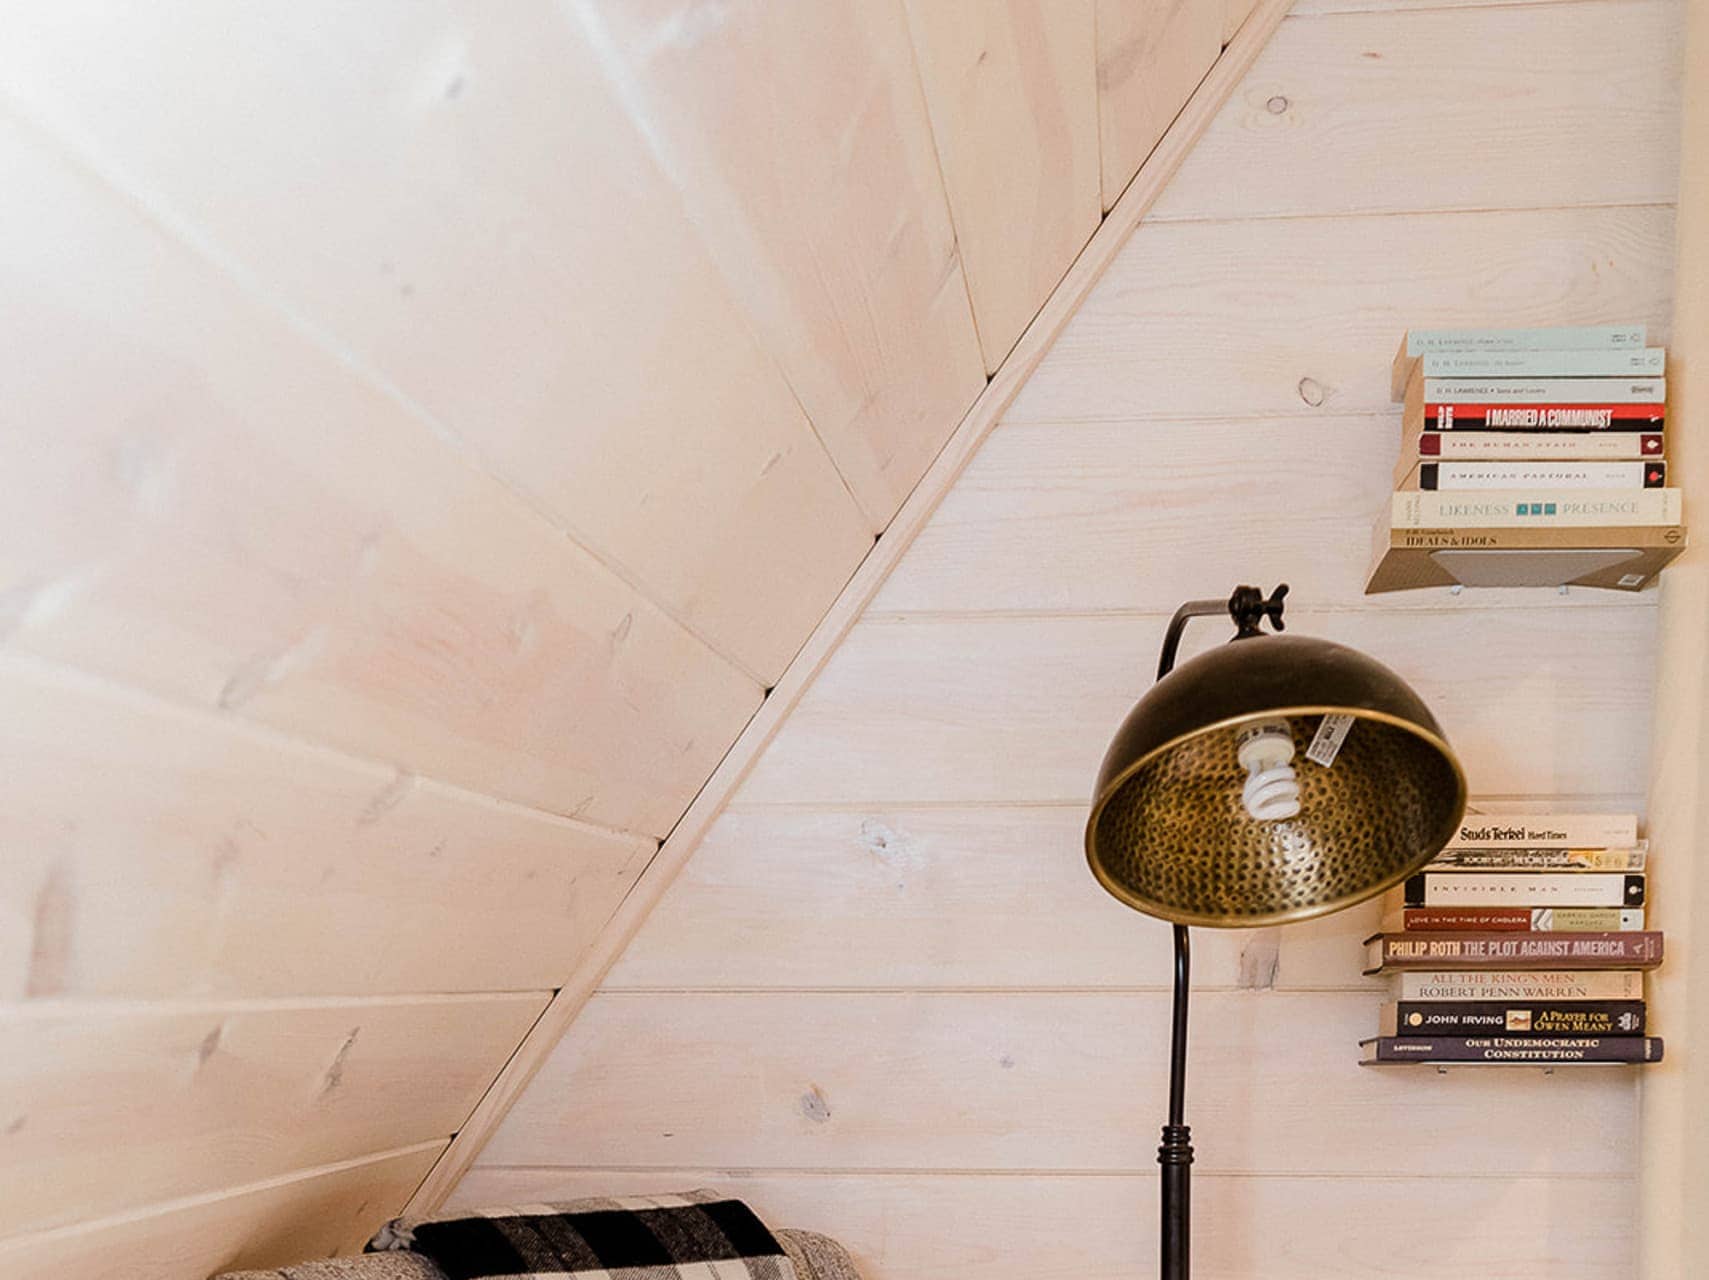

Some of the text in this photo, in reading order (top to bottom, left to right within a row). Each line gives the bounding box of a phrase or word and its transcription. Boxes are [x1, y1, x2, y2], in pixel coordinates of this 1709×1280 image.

[1485, 409, 1614, 429] I MARRIED A COMMUNIST
[1439, 504, 1510, 518] LIKENESS
[1563, 502, 1640, 515] PRESENCE
[1405, 536, 1498, 546] IDEALS & IDOLS
[1460, 827, 1491, 841] Studs
[1433, 885, 1559, 893] INVISIBLE MAN
[1491, 916, 1528, 924] CHOLERA
[1389, 941, 1428, 957] PHILIP
[1429, 941, 1461, 957] ROTH
[1463, 941, 1486, 957] THE
[1488, 941, 1519, 957] PLOT
[1520, 940, 1571, 957] AGAINST
[1572, 940, 1625, 957] AMERICA
[1431, 974, 1456, 984] ALL
[1461, 974, 1485, 984] THE
[1542, 974, 1576, 984] MEN
[1419, 987, 1588, 998] ROBERT PENN WARREN
[1425, 1015, 1504, 1025] JOHN IRVING
[1539, 1011, 1549, 1022] A
[1588, 1012, 1609, 1022] FOR
[1534, 1021, 1614, 1031] OWEN MEANY
[1465, 1037, 1601, 1048] OUR UNDEMOCRATIC
[1484, 1049, 1585, 1059] CONSTITUTION
